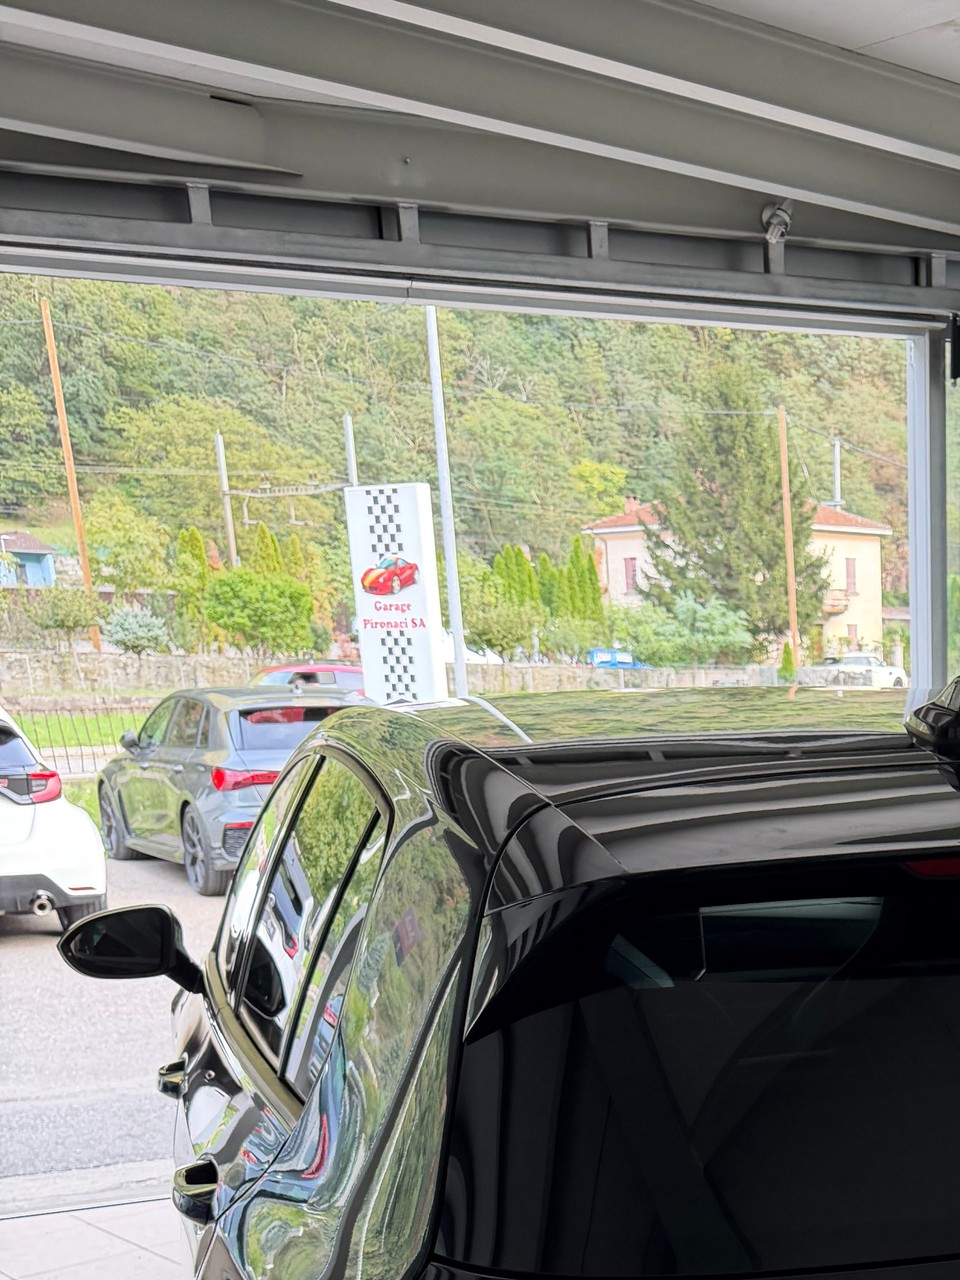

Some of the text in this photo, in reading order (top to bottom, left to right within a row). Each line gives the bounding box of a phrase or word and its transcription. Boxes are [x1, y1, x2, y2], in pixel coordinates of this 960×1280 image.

[374, 601, 412, 613] Garage
[363, 617, 426, 629] Pironaci SA
